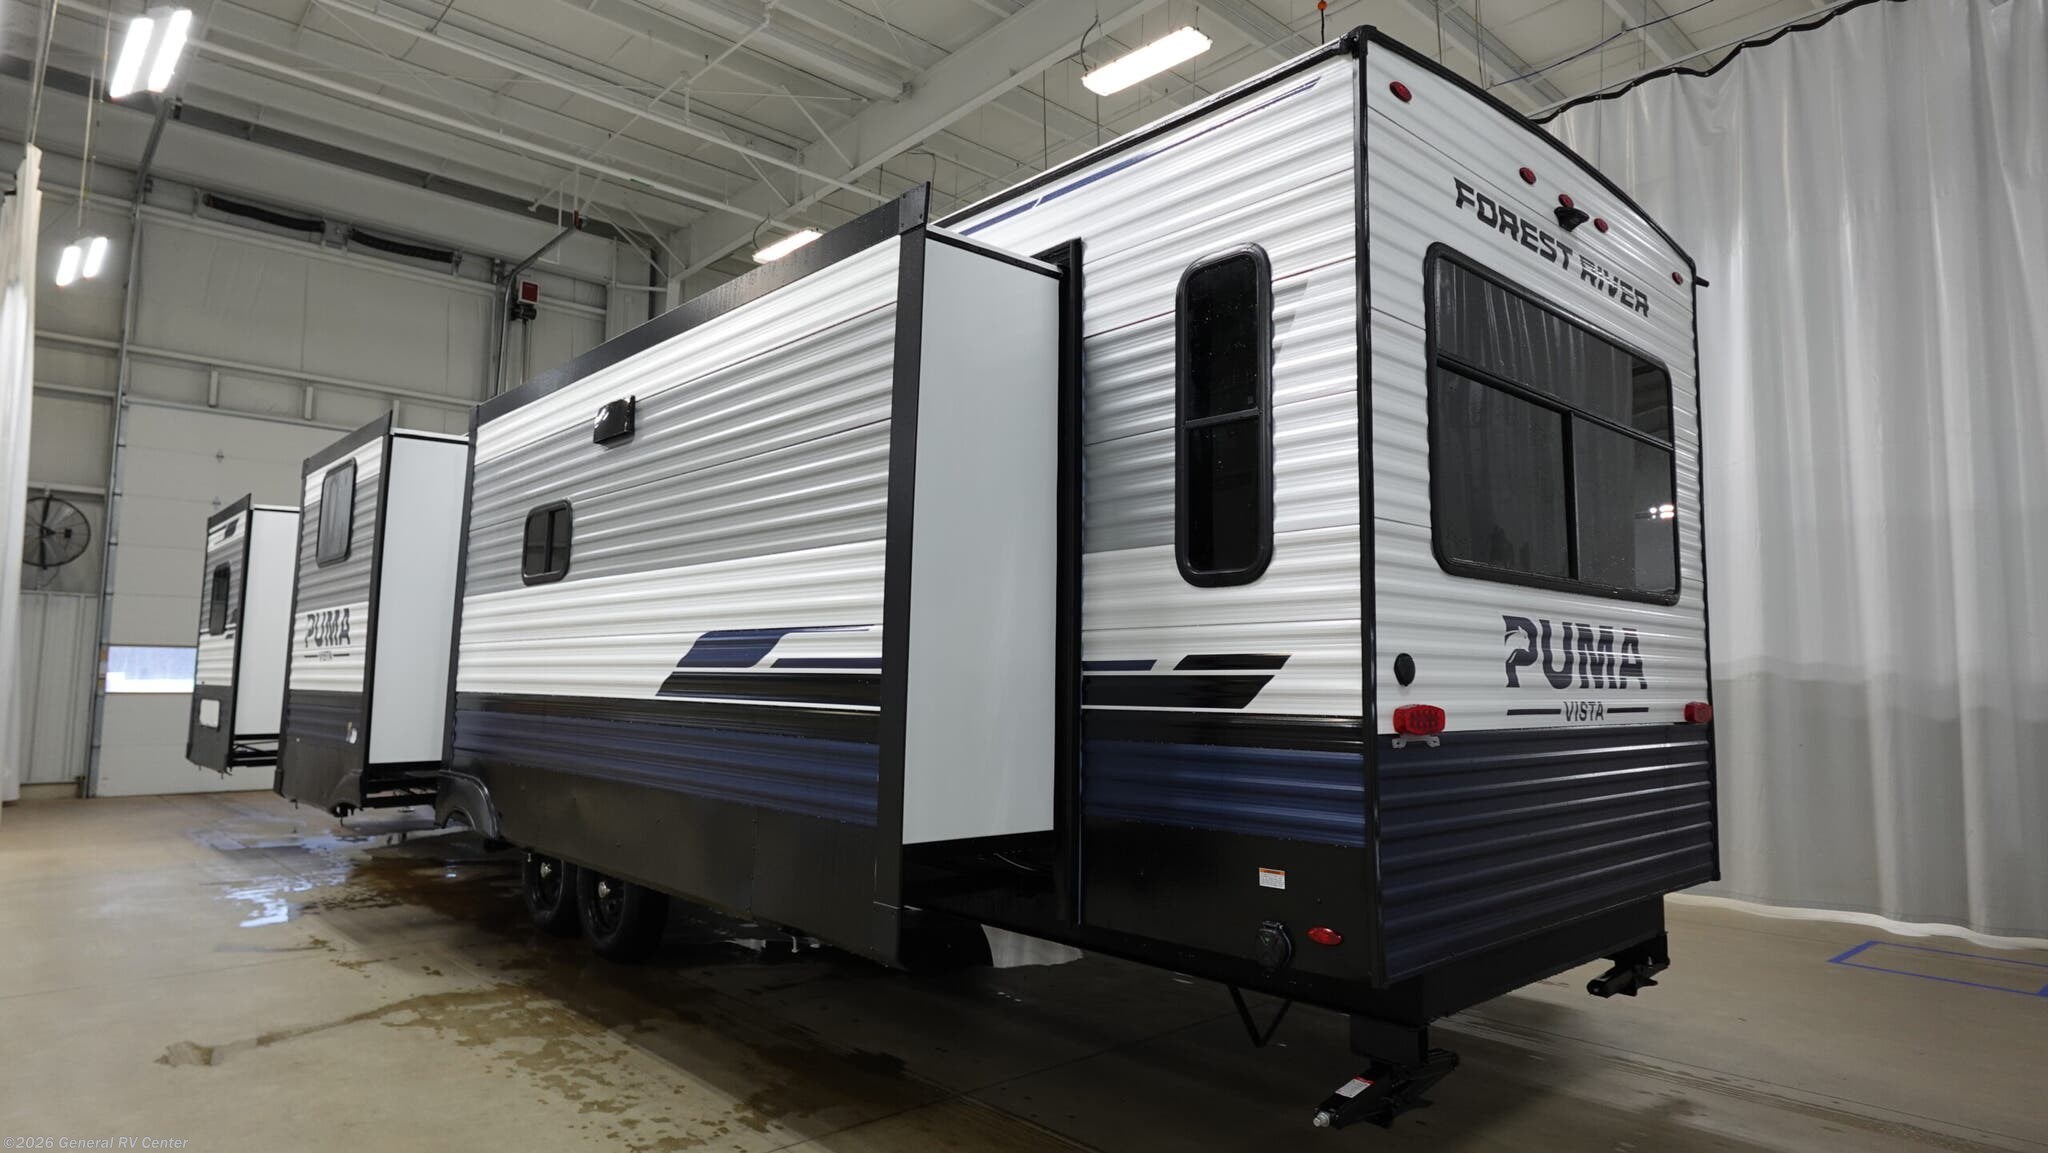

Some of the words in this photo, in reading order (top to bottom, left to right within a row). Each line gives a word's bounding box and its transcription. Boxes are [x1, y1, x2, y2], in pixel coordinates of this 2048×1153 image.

[1454, 176, 1574, 271] FOREST
[1579, 254, 1650, 318] RIVER
[305, 608, 351, 648] PUMA
[1502, 614, 1648, 690] PUMA
[1563, 700, 1605, 722] VISTA
